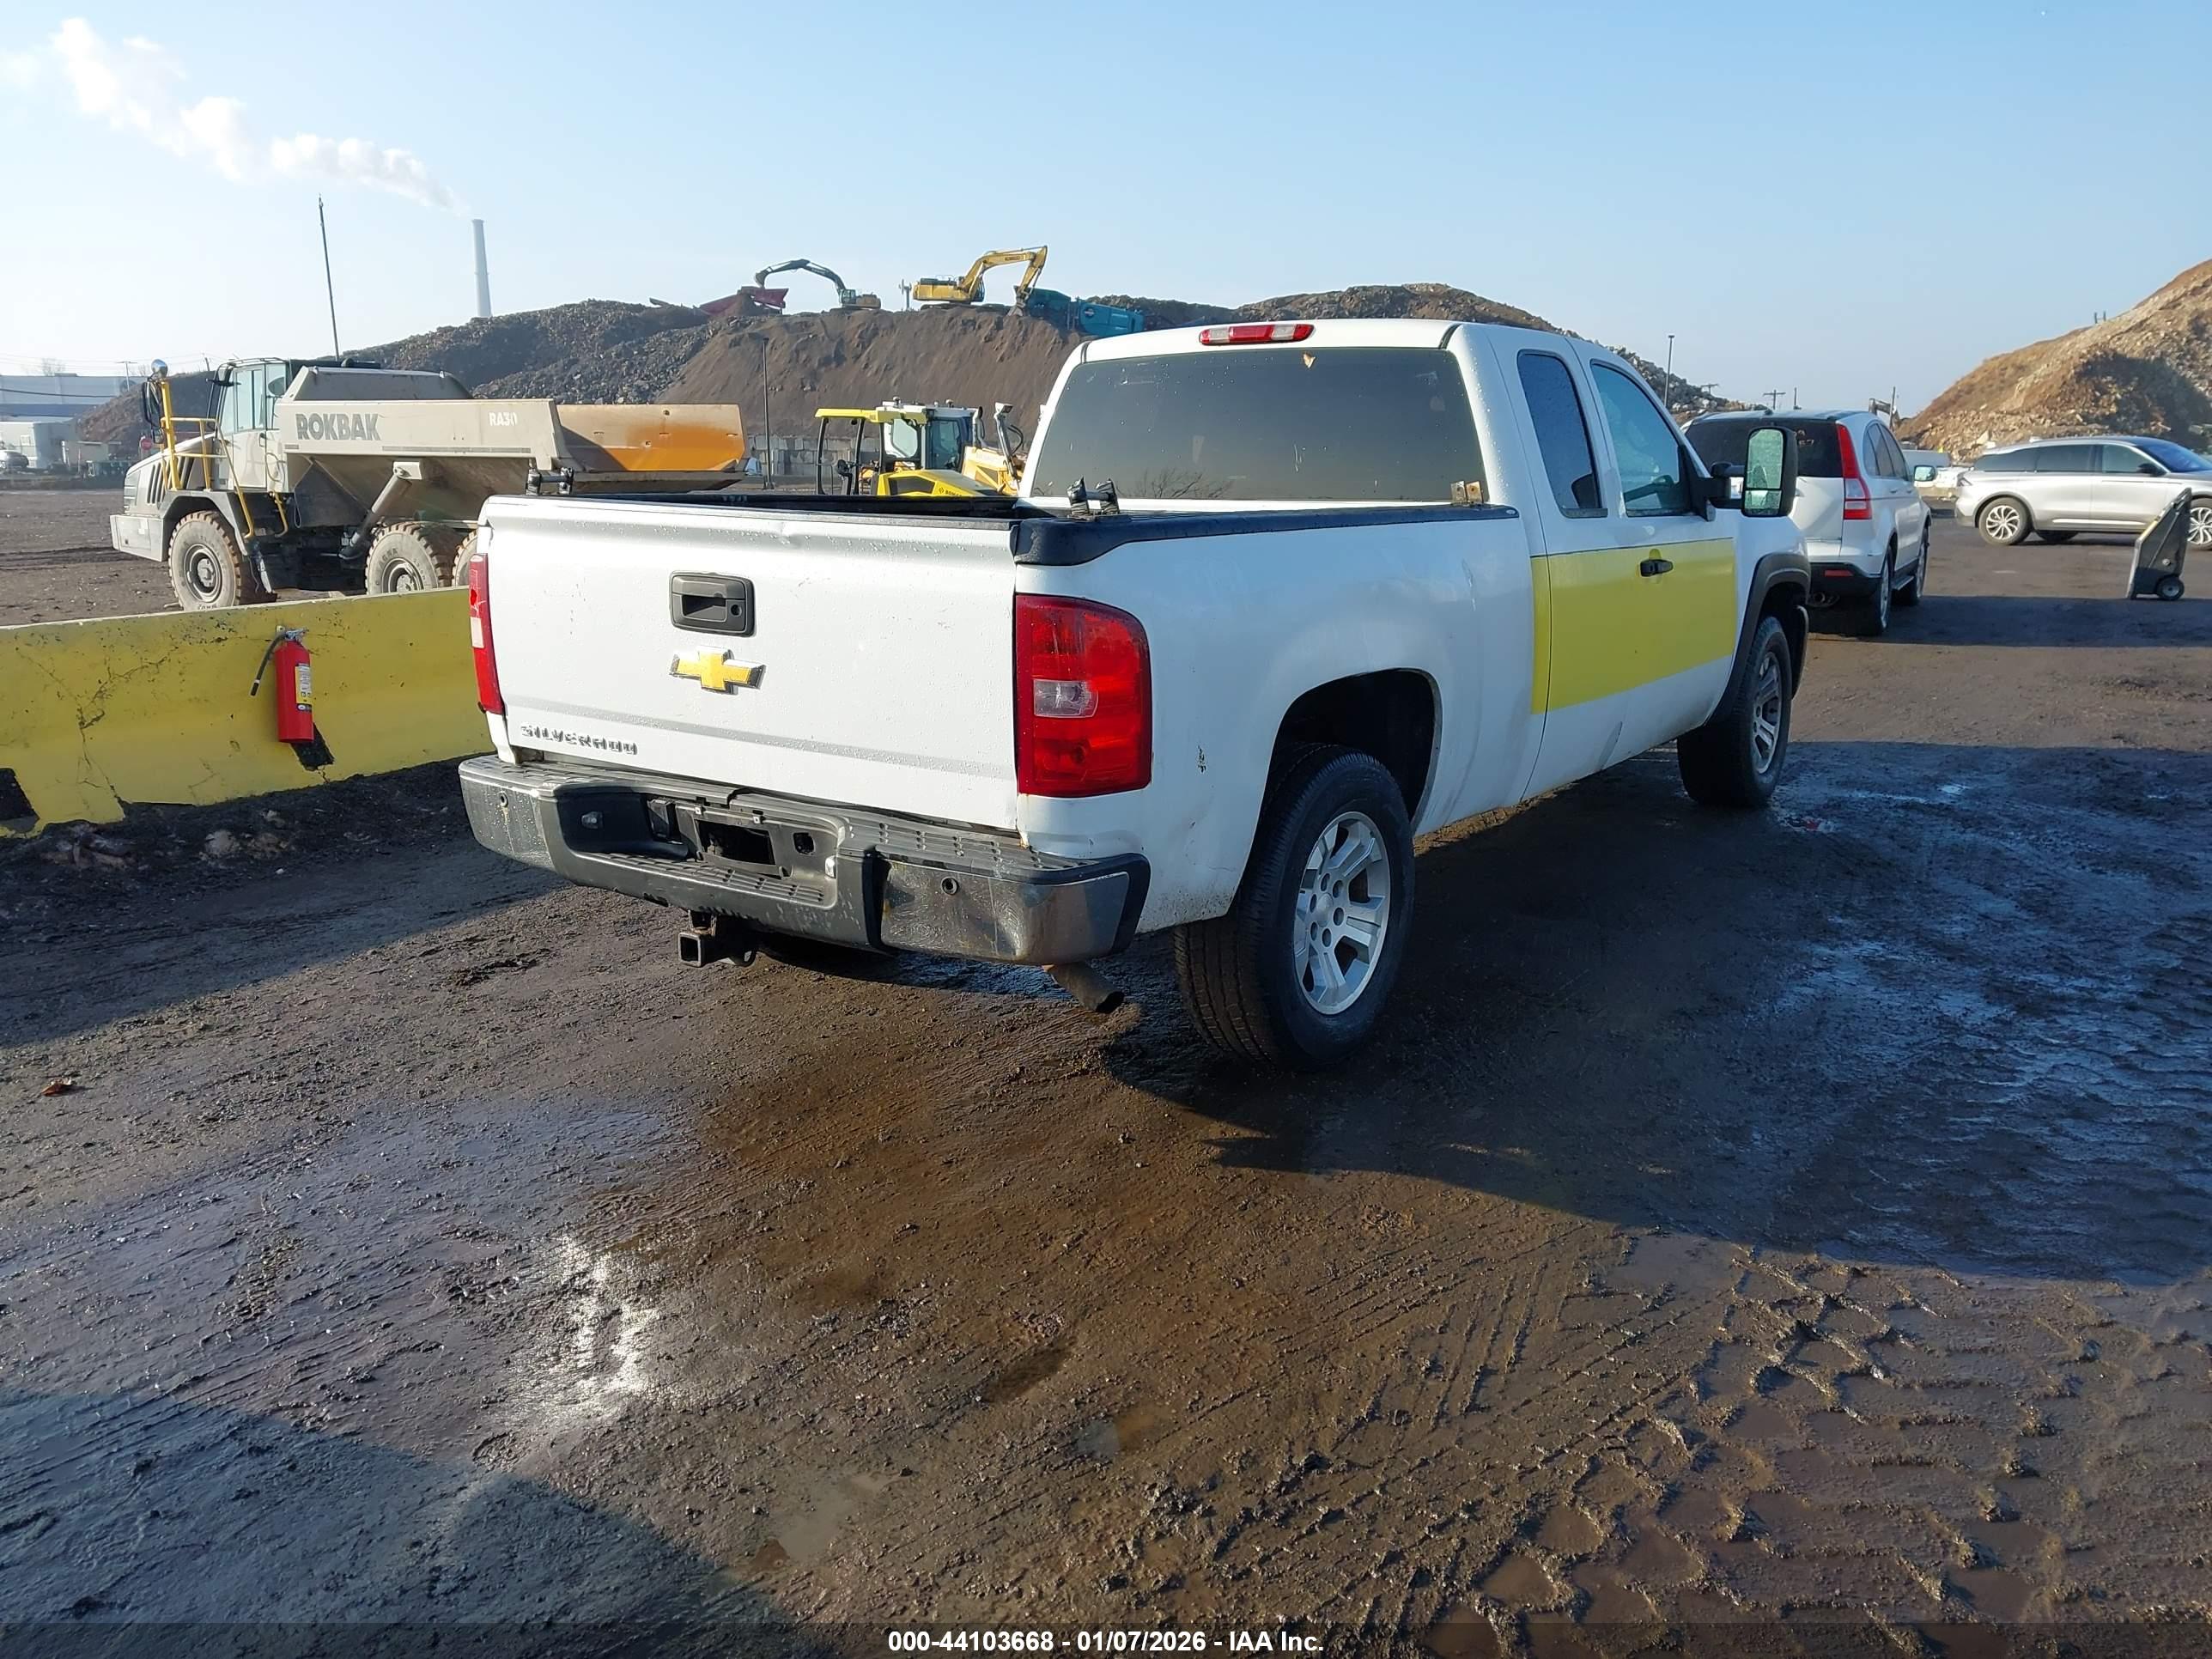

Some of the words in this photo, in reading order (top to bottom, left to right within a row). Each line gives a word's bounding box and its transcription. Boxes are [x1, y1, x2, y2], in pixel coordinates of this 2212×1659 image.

[295, 413, 381, 441] ROKBAK
[489, 411, 518, 427] RA30
[520, 725, 638, 756] SILVERADO
